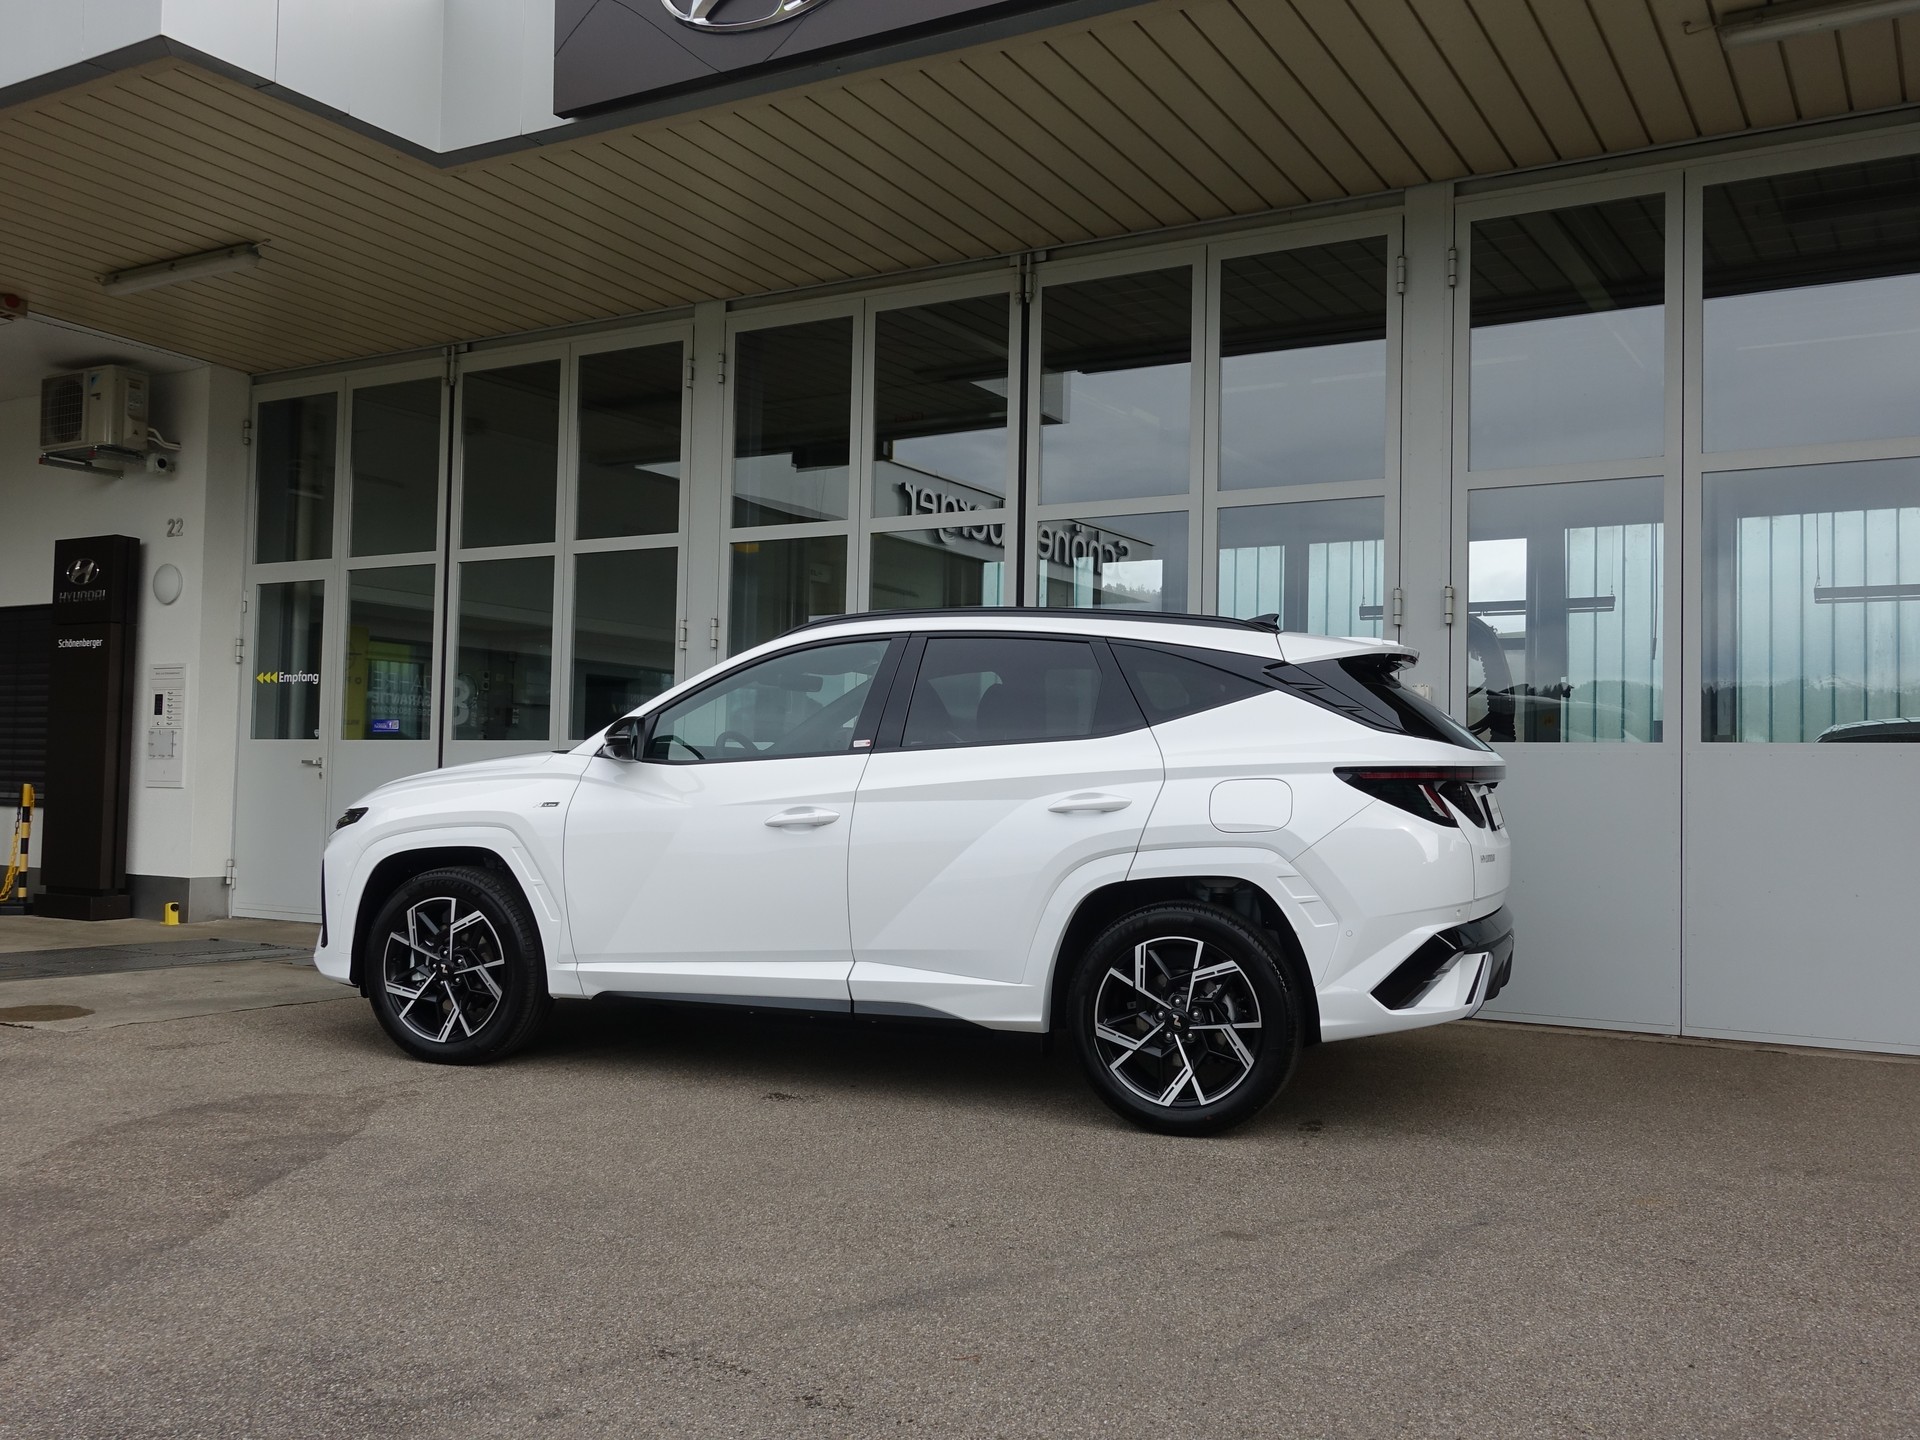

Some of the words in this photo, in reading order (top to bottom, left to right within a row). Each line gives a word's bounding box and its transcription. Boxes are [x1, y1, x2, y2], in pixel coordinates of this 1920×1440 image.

[166, 517, 184, 537] 22
[58, 589, 106, 604] HYUNDAI
[57, 638, 103, 649] Schönenberger
[278, 670, 320, 685] Empfang
